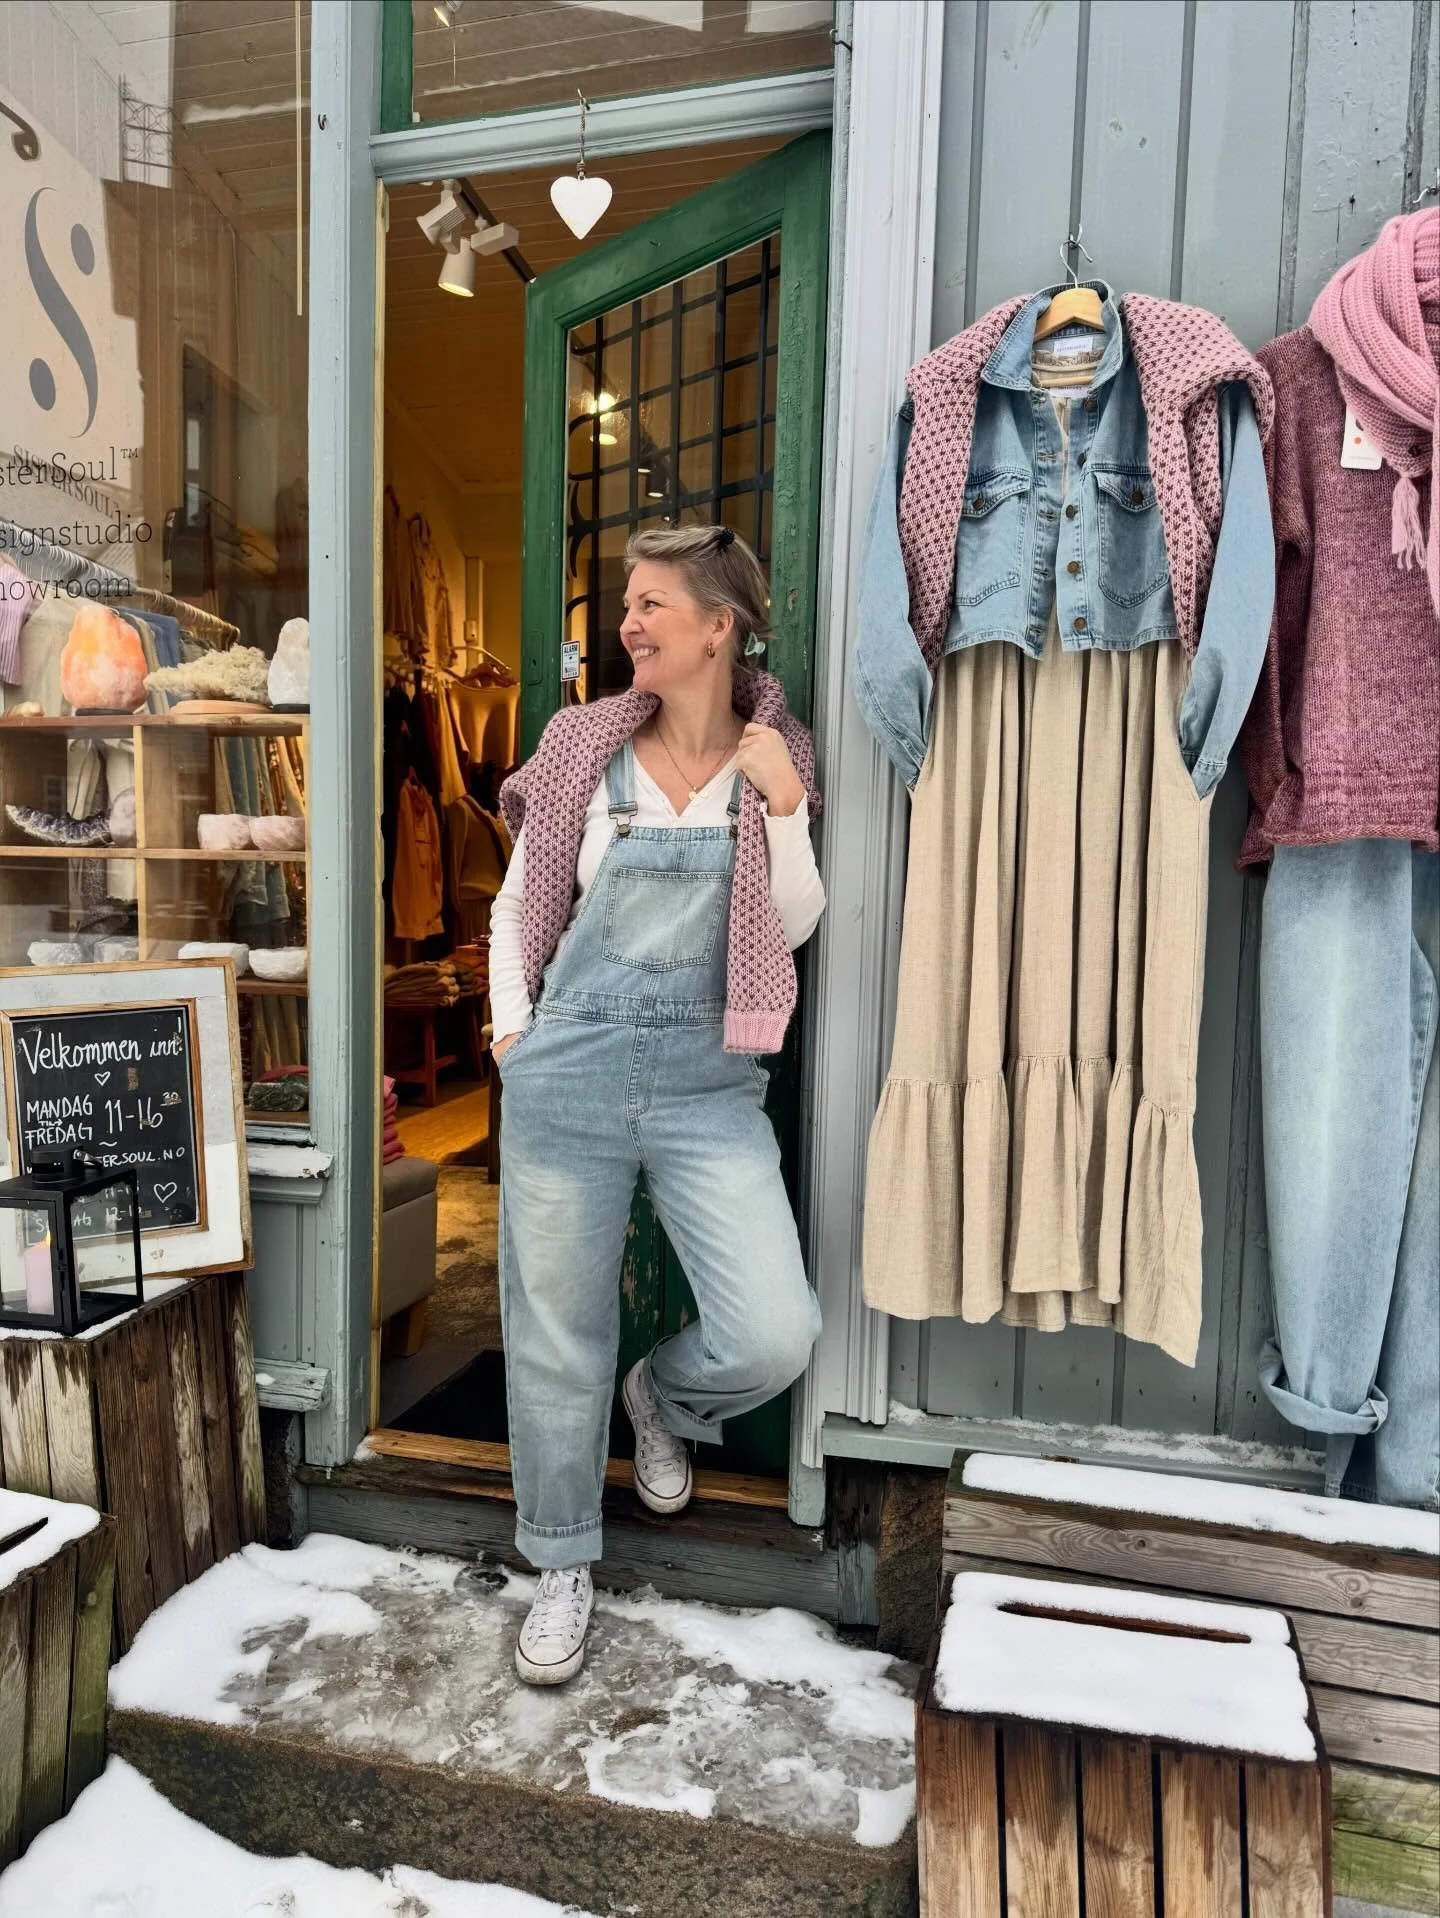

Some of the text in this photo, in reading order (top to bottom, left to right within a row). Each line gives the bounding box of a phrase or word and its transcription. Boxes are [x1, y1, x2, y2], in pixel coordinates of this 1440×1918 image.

[21, 1031, 141, 1074] Velkommen
[26, 1094, 93, 1123] MANDAG
[105, 1097, 163, 1134] 11-16
[25, 1122, 93, 1150] FREDAG
